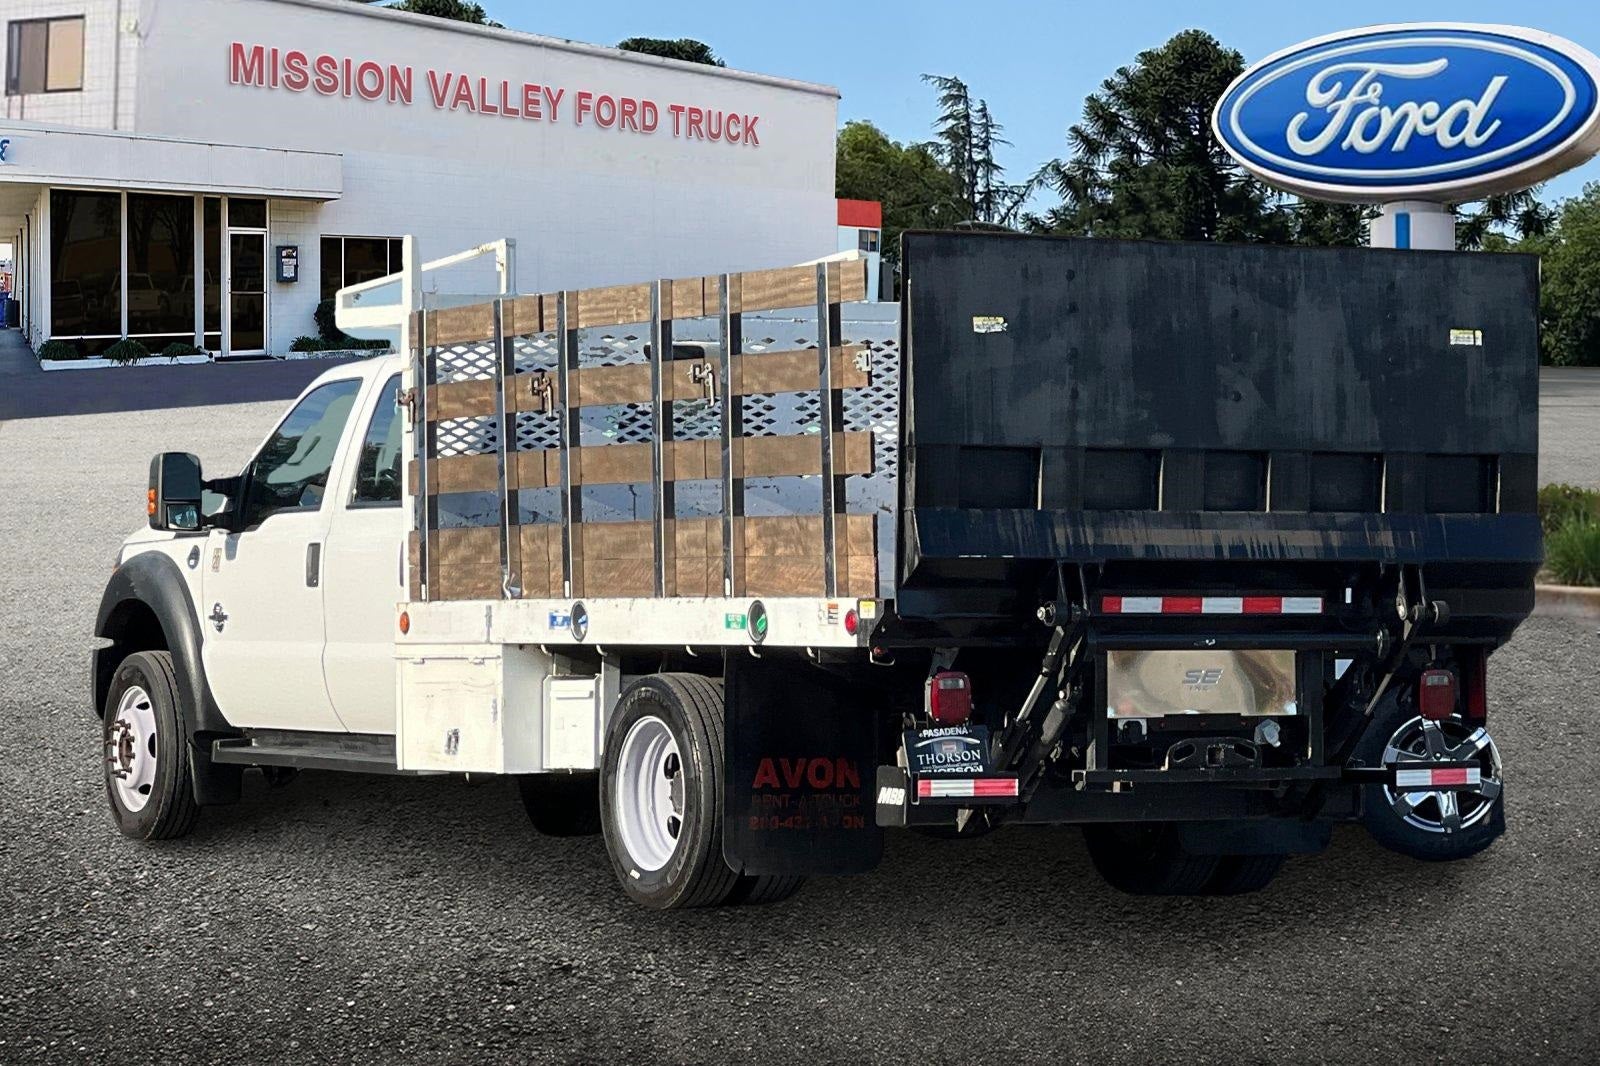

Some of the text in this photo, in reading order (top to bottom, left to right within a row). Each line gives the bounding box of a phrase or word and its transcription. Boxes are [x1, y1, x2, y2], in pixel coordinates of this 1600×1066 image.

[230, 41, 760, 146] MISSION VALLEY FORD TRUCK
[1286, 58, 1508, 156] Ford
[922, 726, 969, 738] PASADENA
[752, 757, 862, 790] AVON
[917, 749, 981, 766] THORSON
